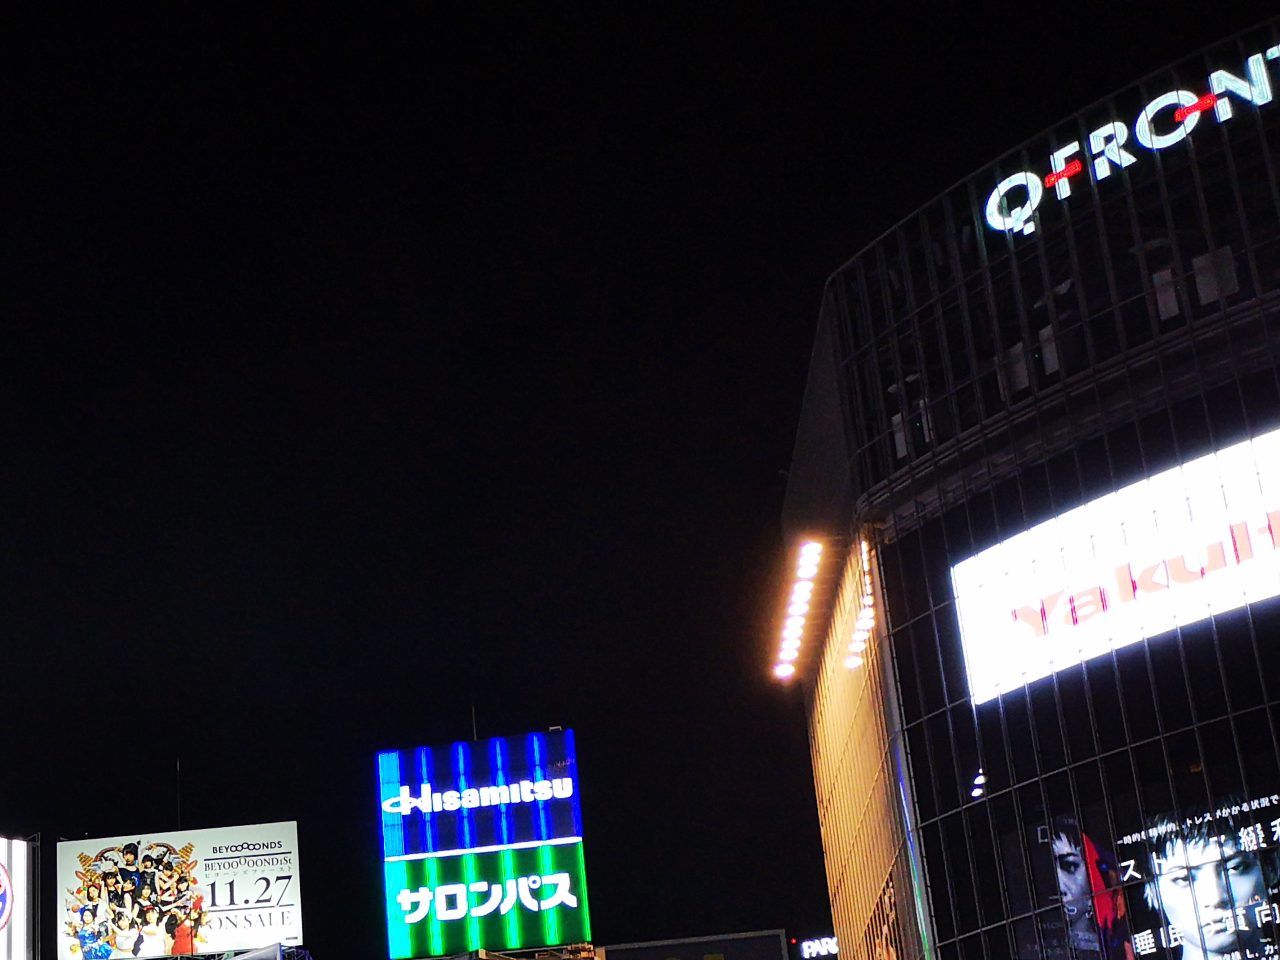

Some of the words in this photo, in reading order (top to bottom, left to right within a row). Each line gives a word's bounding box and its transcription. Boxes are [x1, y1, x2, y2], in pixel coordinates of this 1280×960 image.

[986, 45, 1280, 235] QFRON
[382, 777, 573, 816] Hisamitsu
[207, 875, 293, 907] 11.27
[397, 872, 578, 924] サロンパス
